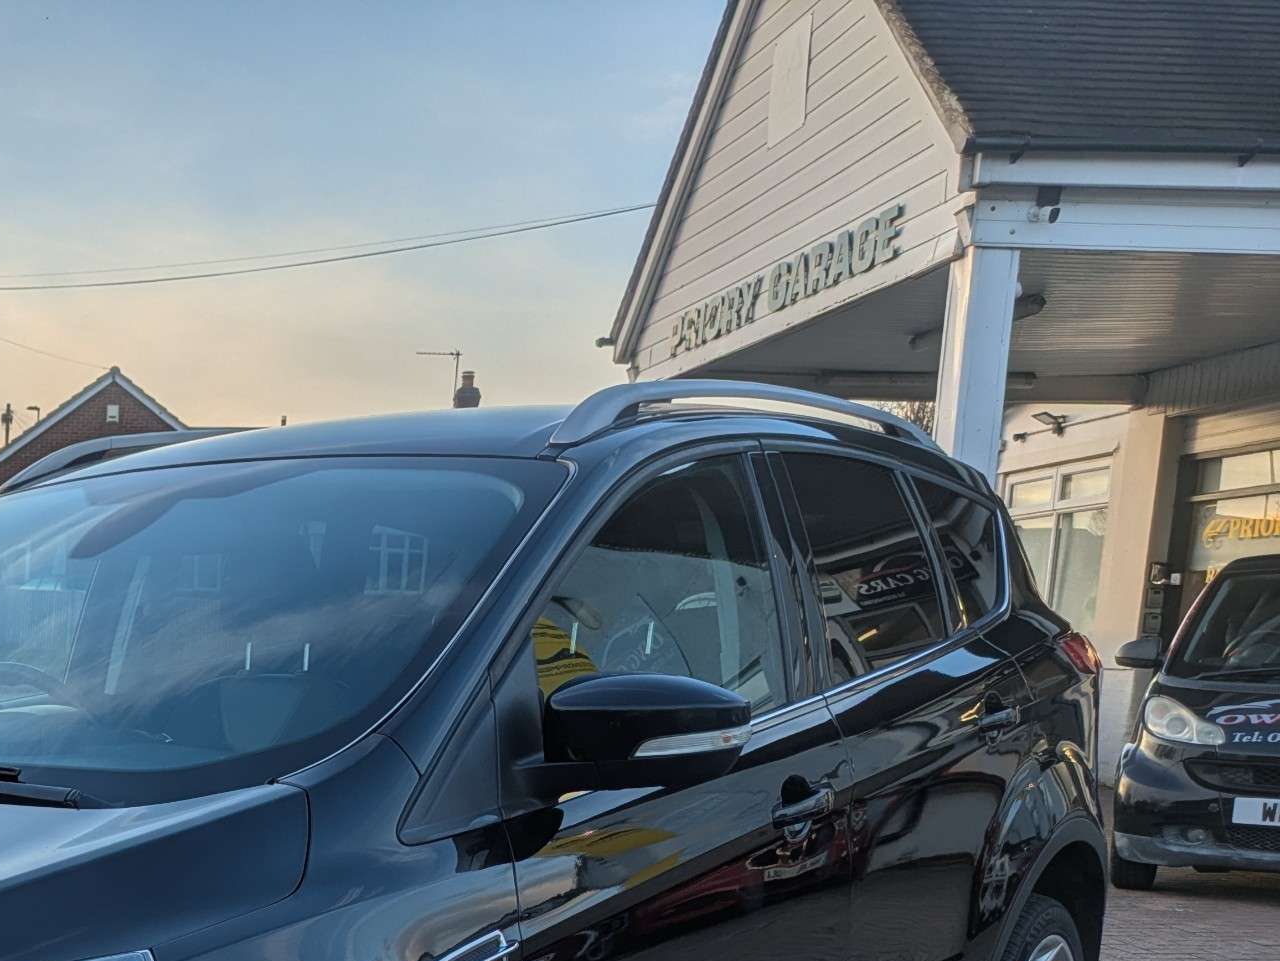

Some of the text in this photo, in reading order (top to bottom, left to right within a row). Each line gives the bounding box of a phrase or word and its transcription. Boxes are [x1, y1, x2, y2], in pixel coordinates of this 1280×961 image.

[670, 203, 906, 358] PRIORY GARAGE
[1227, 518, 1280, 539] PRIO
[1232, 731, 1263, 743] Tel:
